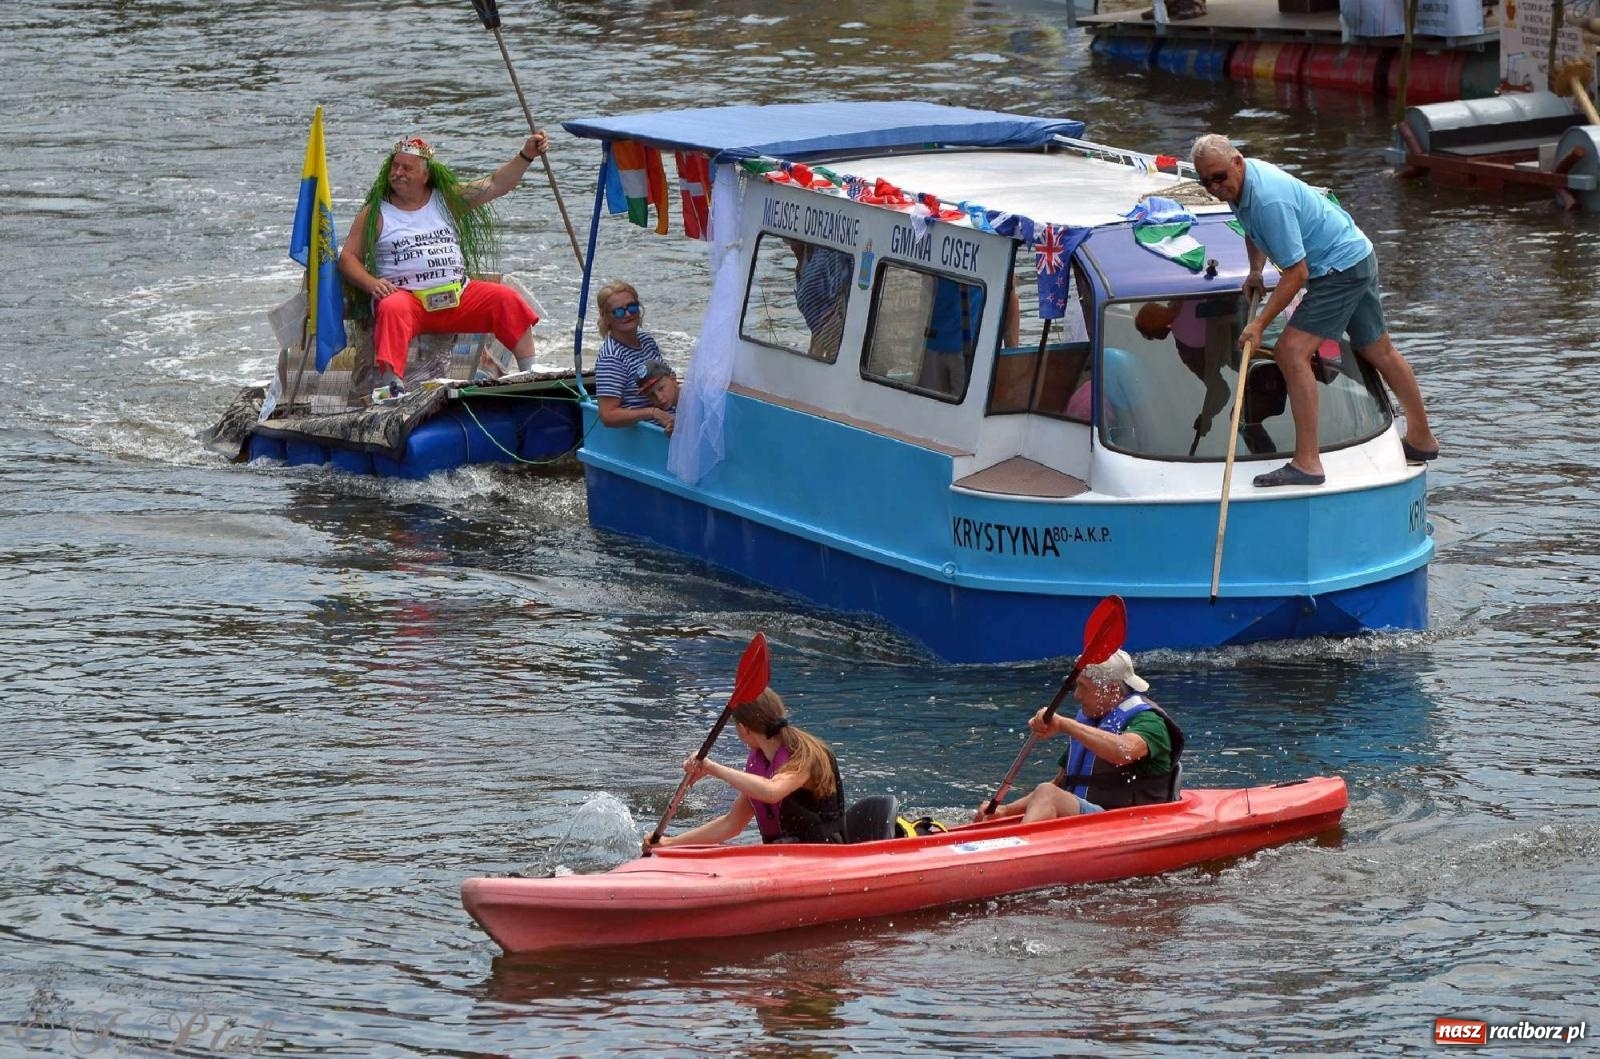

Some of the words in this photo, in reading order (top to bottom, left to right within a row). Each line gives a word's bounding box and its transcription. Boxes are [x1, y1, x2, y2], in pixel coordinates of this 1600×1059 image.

[762, 197, 800, 232] MIEJSCE
[804, 206, 860, 247] ODRZAŃSKIE
[891, 224, 932, 262] GMINA
[941, 235, 980, 273] CISEK
[952, 516, 1060, 558] KRYSTYNA
[1053, 526, 1113, 543] 80-A.K.P.
